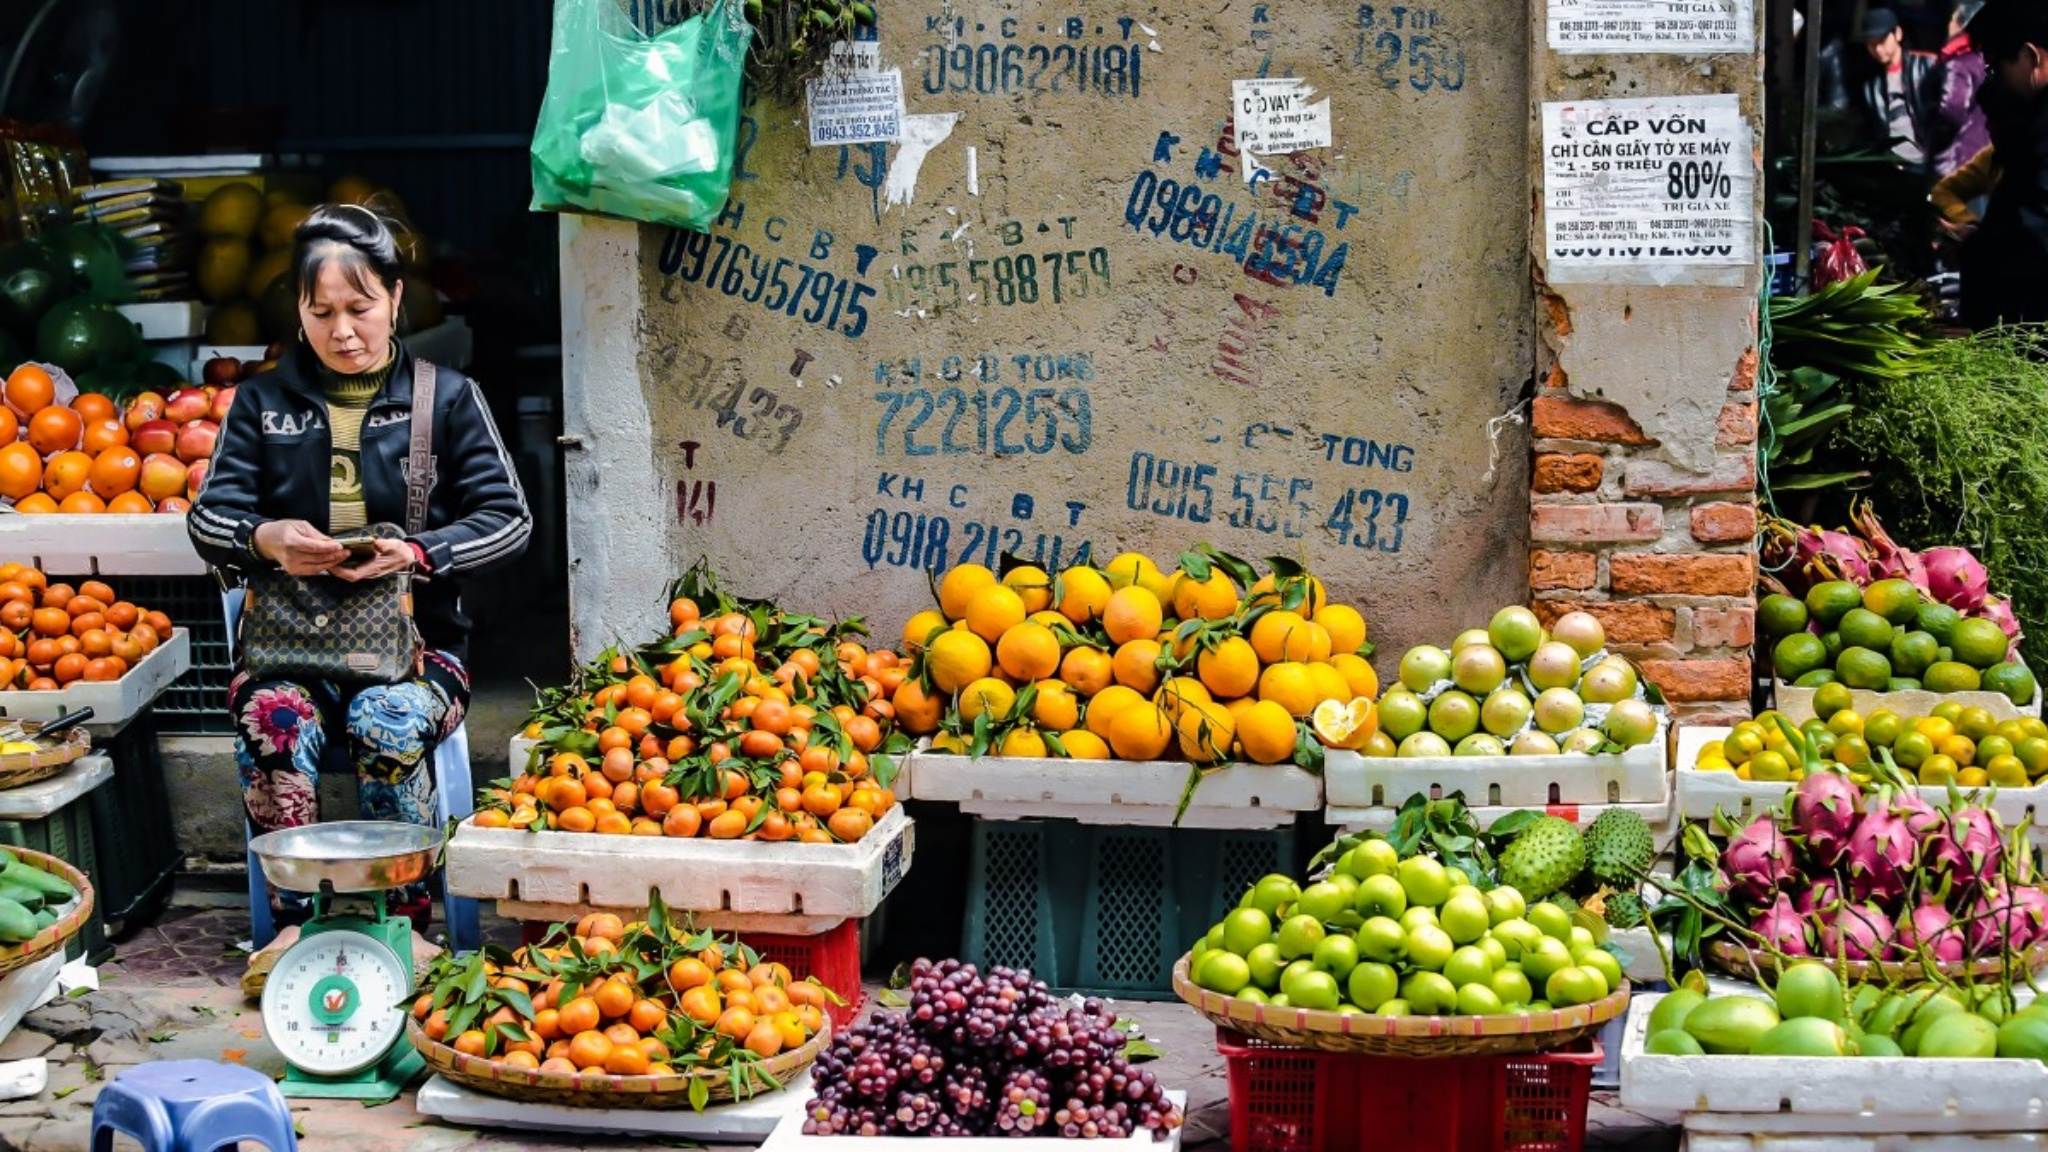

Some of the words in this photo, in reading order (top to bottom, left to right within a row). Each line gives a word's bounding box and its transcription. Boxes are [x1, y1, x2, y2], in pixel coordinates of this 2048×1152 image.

[1586, 115, 1639, 136] CẤP
[1648, 113, 1706, 134] VỐN
[1567, 162, 1576, 171] 1
[1592, 161, 1610, 171] 50
[1615, 158, 1663, 172] TRIỆU
[1679, 142, 1697, 155] XE
[1701, 137, 1731, 155] MÁY
[1667, 160, 1732, 200] 80%
[875, 387, 1093, 456] 7221259
[1322, 433, 1415, 472] TONG
[1127, 451, 1217, 524] 0915
[1327, 487, 1409, 553] 433
[862, 507, 949, 577] 0918
